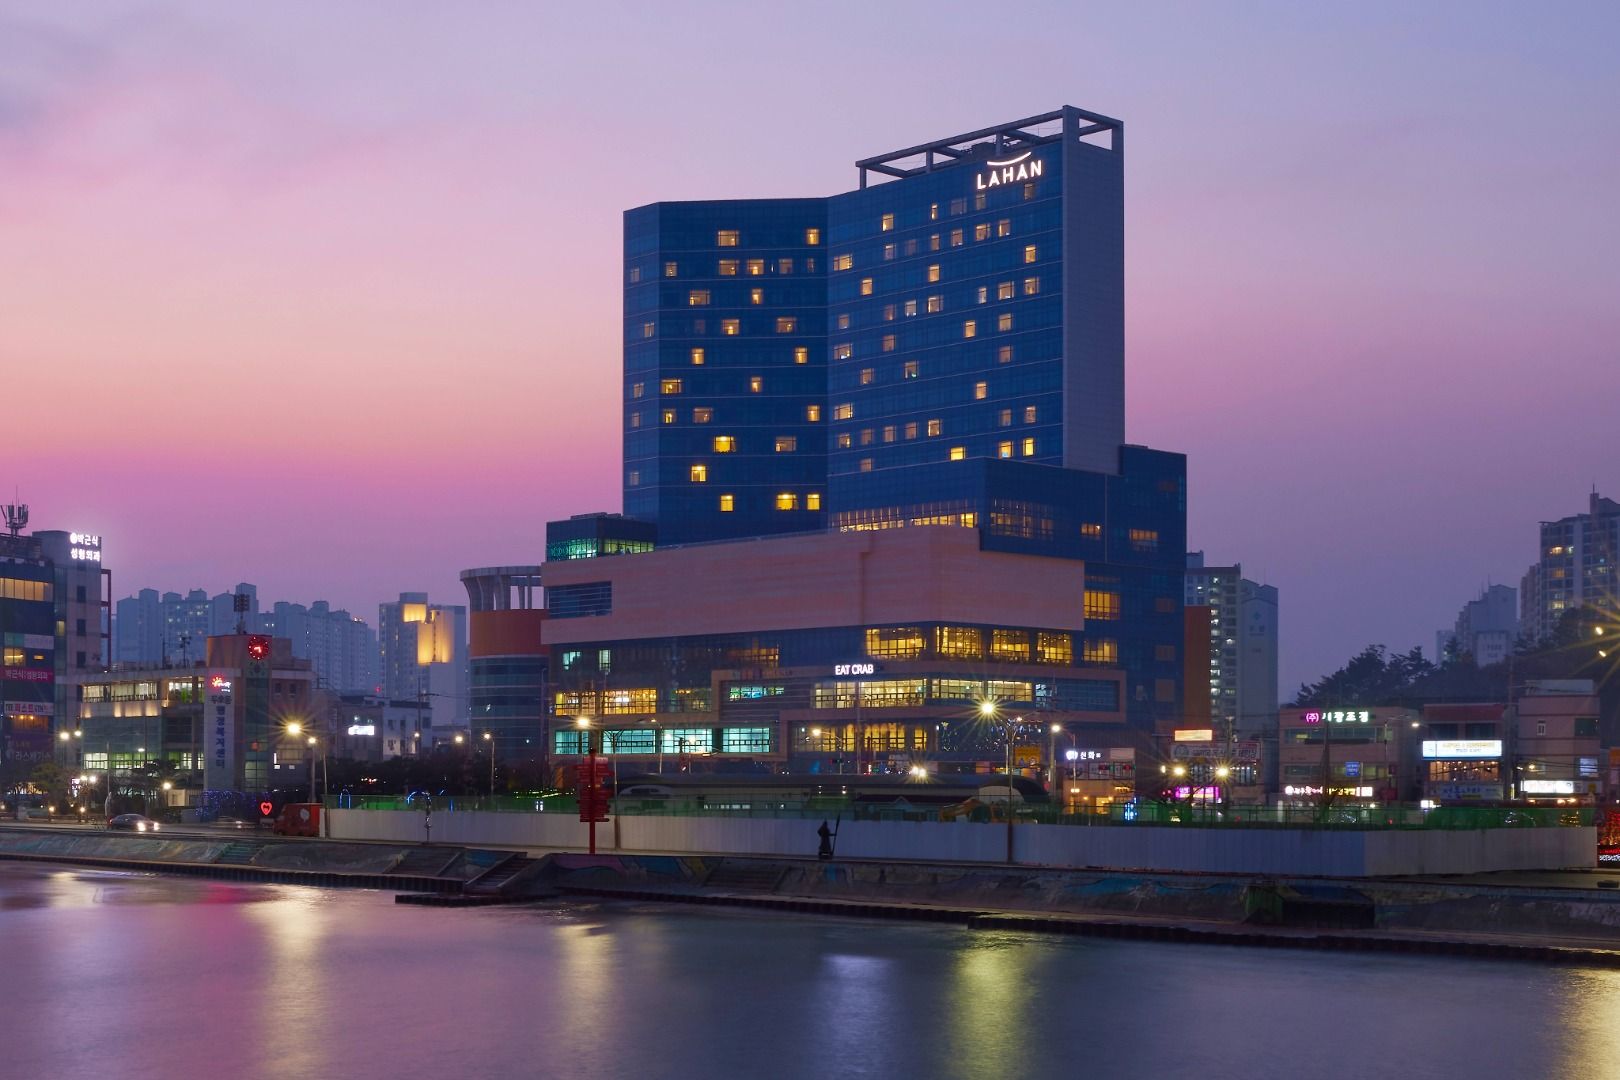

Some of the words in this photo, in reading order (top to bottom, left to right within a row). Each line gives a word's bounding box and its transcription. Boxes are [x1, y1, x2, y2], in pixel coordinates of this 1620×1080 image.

[976, 159, 1042, 190] LAHAN
[77, 534, 99, 546] 박근식
[71, 547, 101, 562] 성형외과
[835, 664, 851, 676] EAT
[851, 663, 874, 675] CRAB
[1306, 712, 1320, 723] (주)
